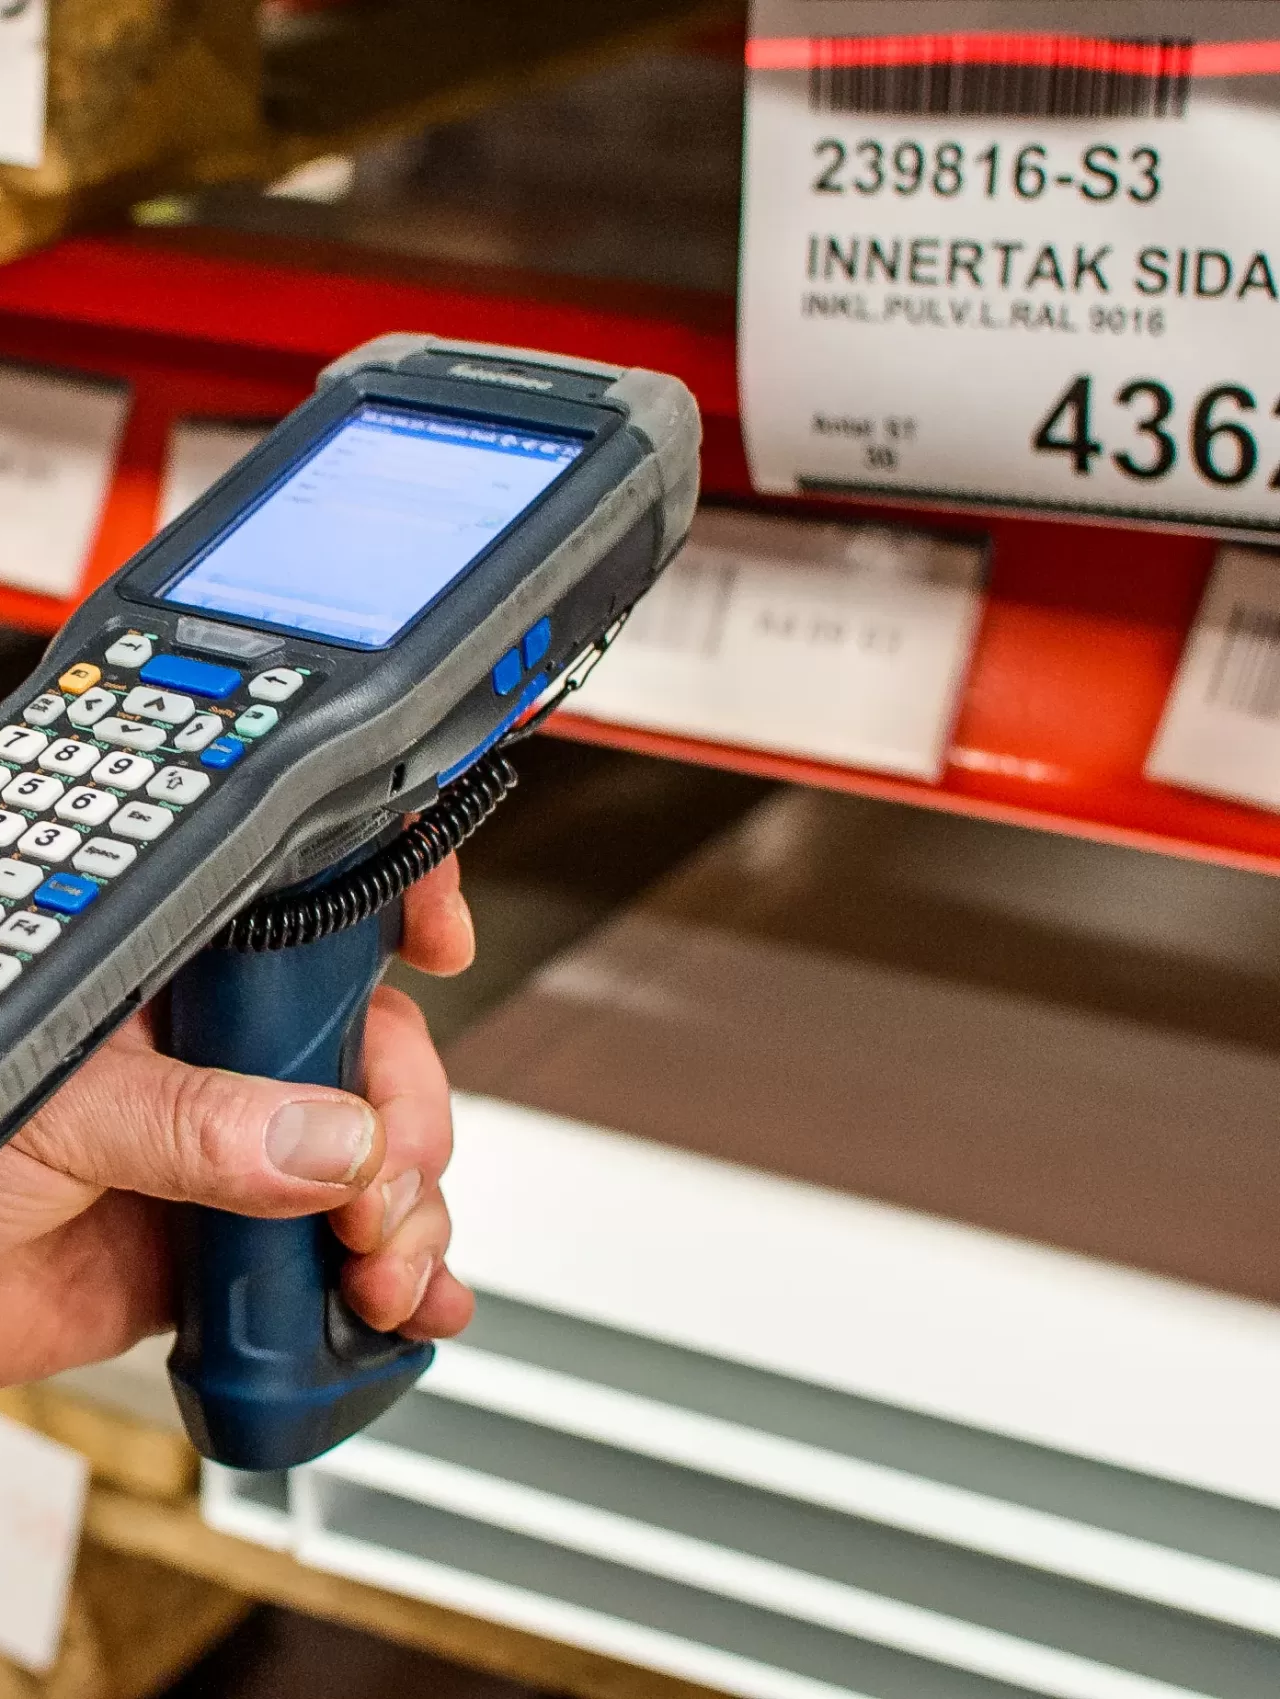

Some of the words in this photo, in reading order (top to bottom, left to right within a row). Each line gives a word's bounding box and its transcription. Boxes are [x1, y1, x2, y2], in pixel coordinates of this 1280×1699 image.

[812, 138, 1162, 204] 239816-S3
[806, 236, 1112, 291] INNERTAK
[1134, 247, 1280, 300] SIDA
[1088, 304, 1166, 337] 9016
[1032, 375, 1280, 490] 436
[3, 730, 30, 749] 7
[53, 744, 81, 762] 8
[108, 757, 134, 776] 9
[17, 778, 46, 796] 5
[70, 792, 98, 810] 6
[33, 827, 61, 847] 3
[9, 918, 41, 937] F4
